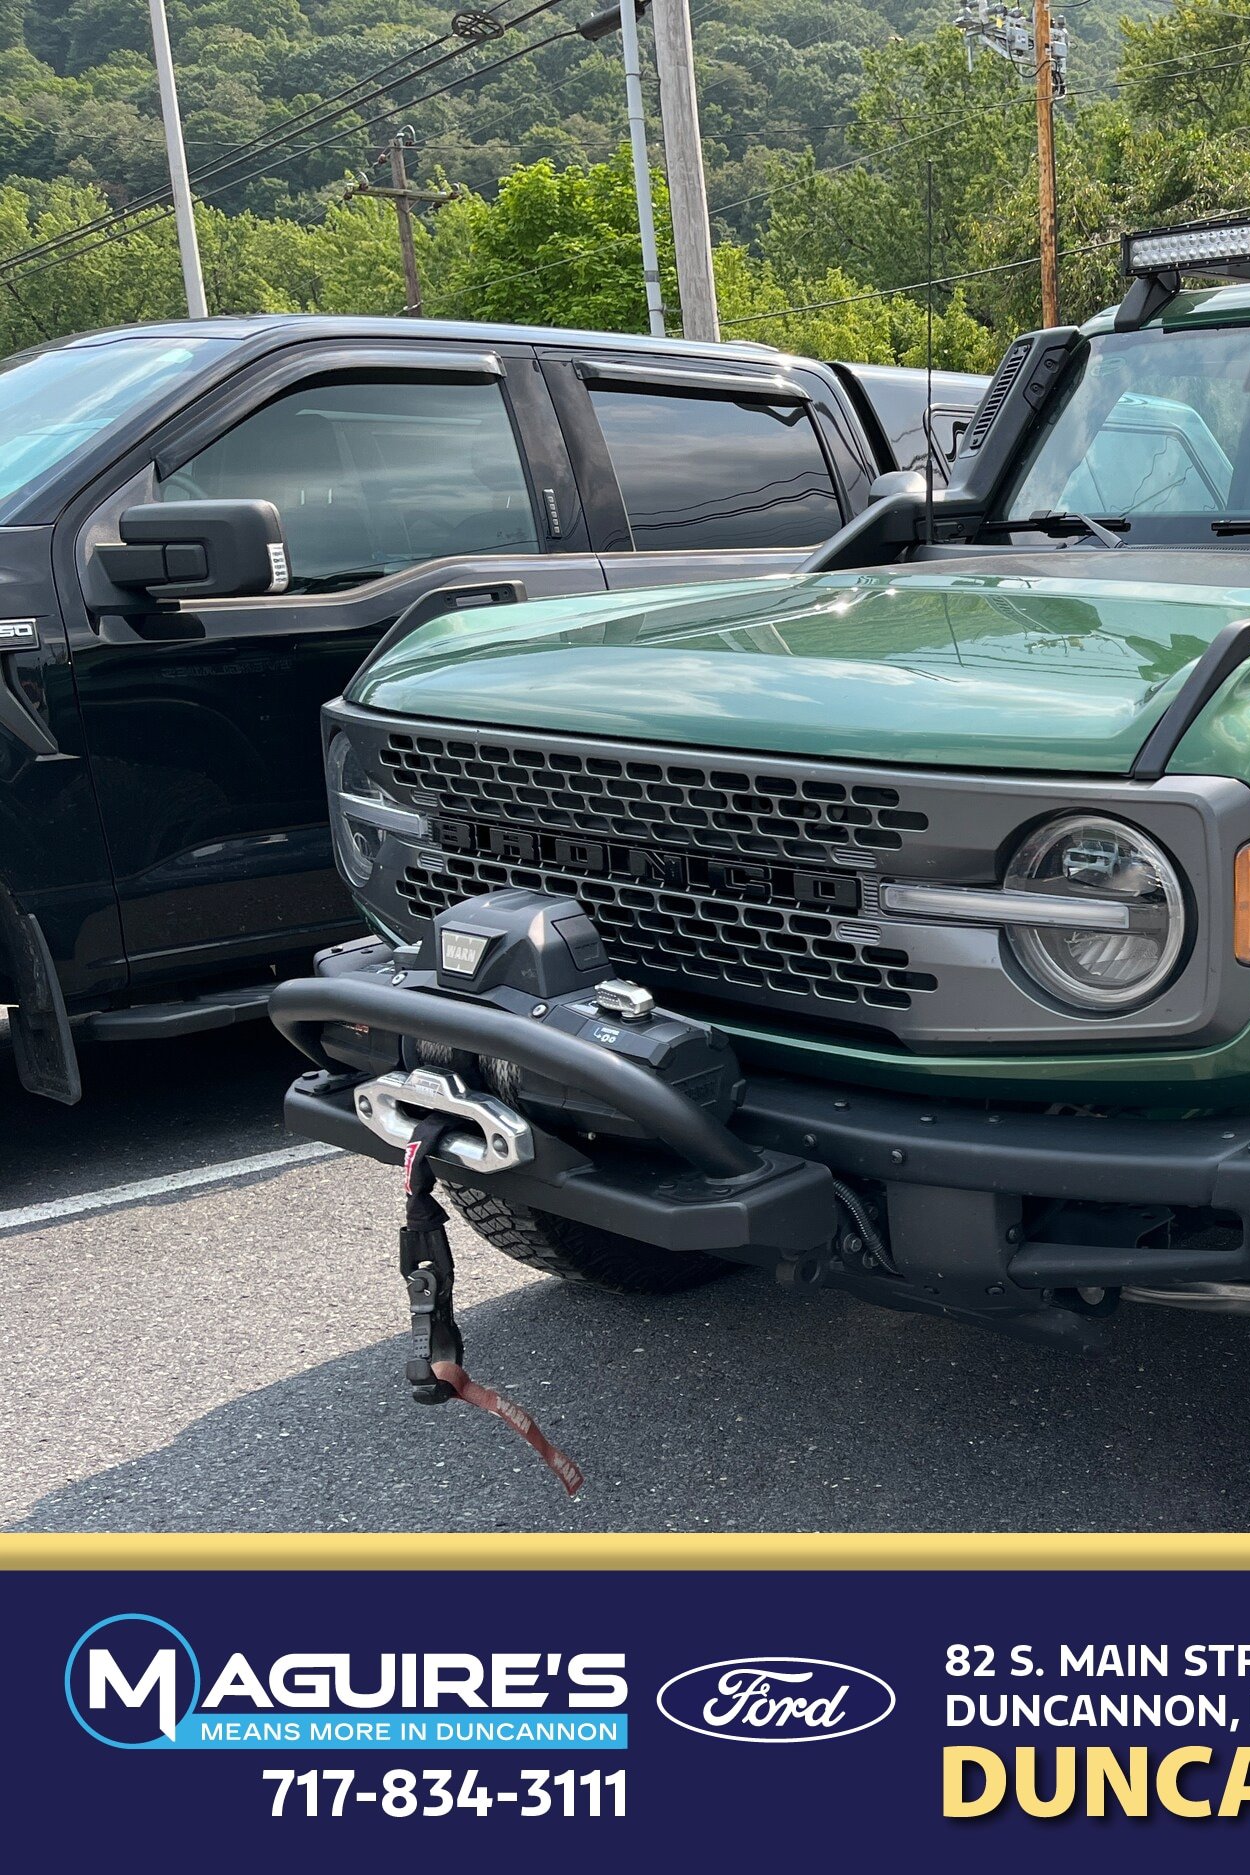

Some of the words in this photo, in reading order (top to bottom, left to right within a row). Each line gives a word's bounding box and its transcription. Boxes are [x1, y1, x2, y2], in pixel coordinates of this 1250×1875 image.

[438, 820, 862, 910] BRONCO
[446, 944, 476, 962] WARN
[496, 1396, 532, 1434] WARN
